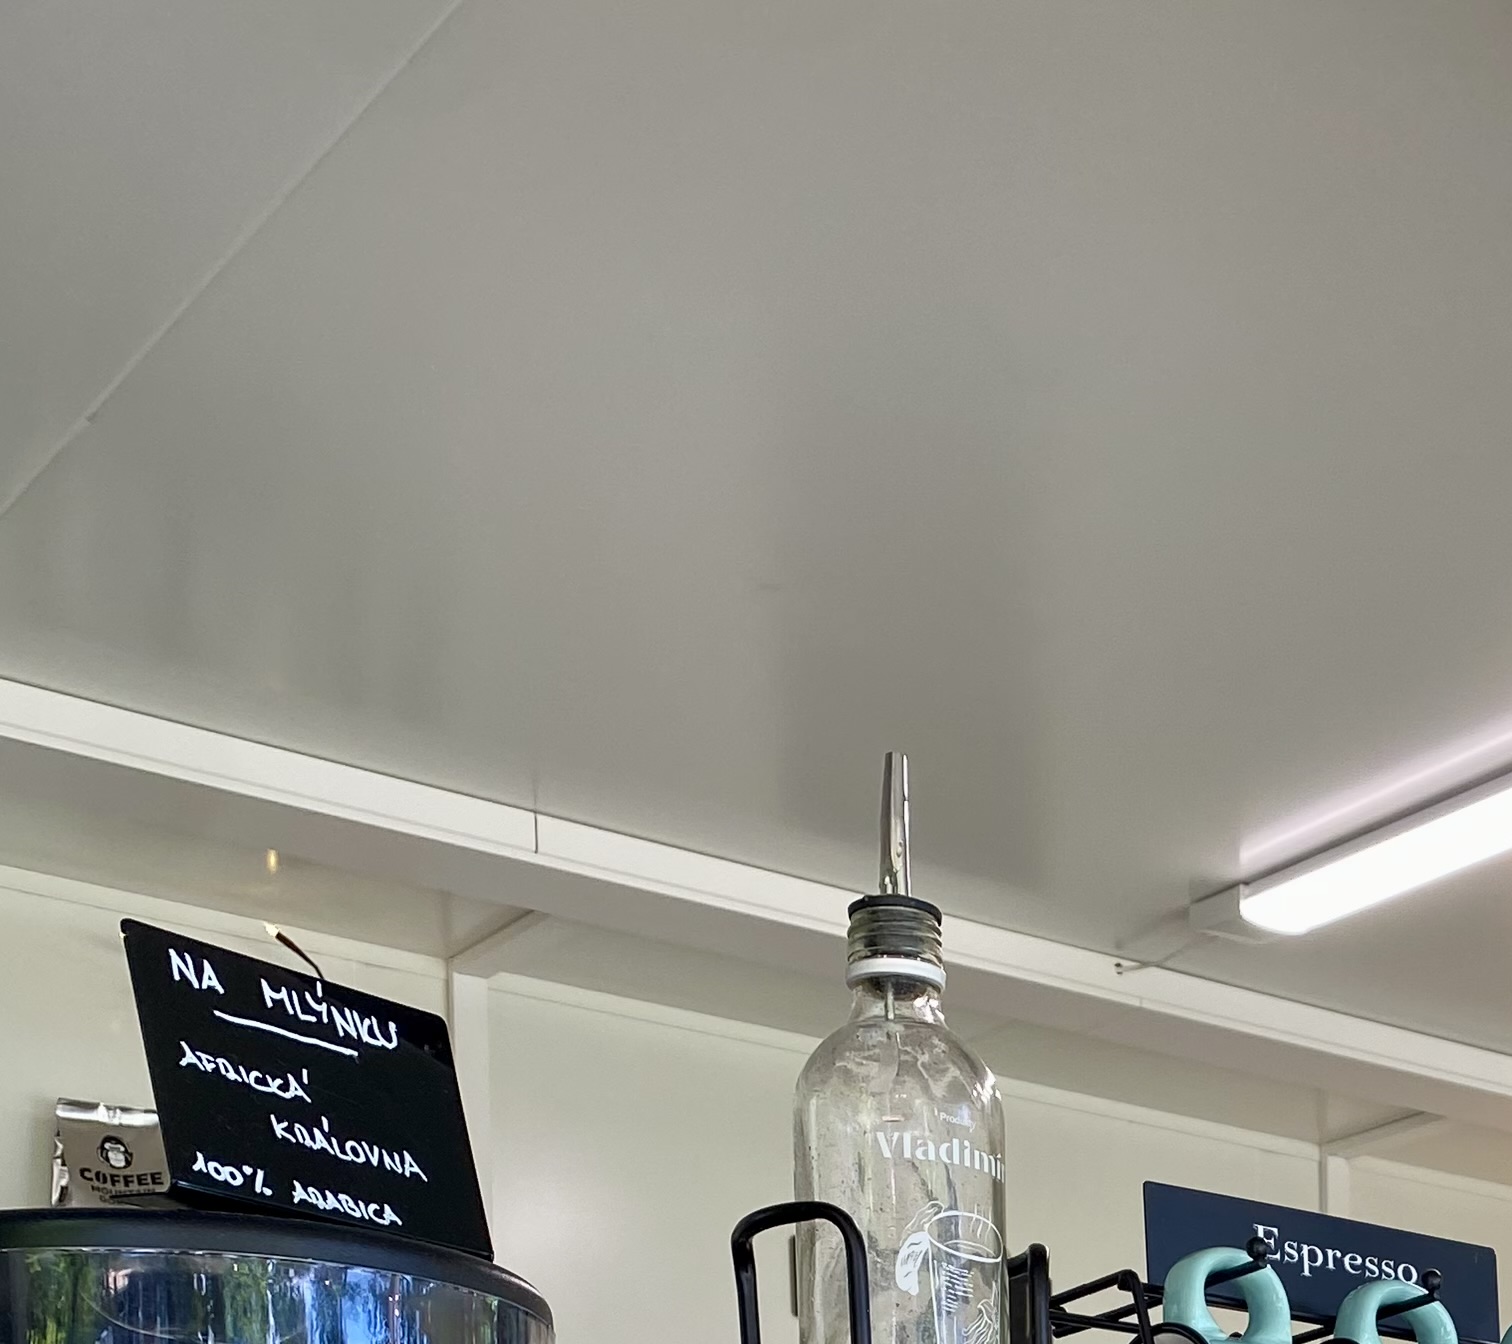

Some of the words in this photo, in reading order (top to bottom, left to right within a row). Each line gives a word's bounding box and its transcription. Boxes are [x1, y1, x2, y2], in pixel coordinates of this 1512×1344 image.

[169, 948, 225, 994] NA
[261, 980, 399, 1050] MLÝNKU
[179, 1041, 312, 1103] AFRICKÁ
[79, 1167, 164, 1188] COFFEE
[270, 1114, 428, 1182] KRÁLOVNA
[192, 1152, 273, 1196] 100%
[291, 1179, 402, 1226] ARABICA
[1253, 1223, 1418, 1286] Espresso
